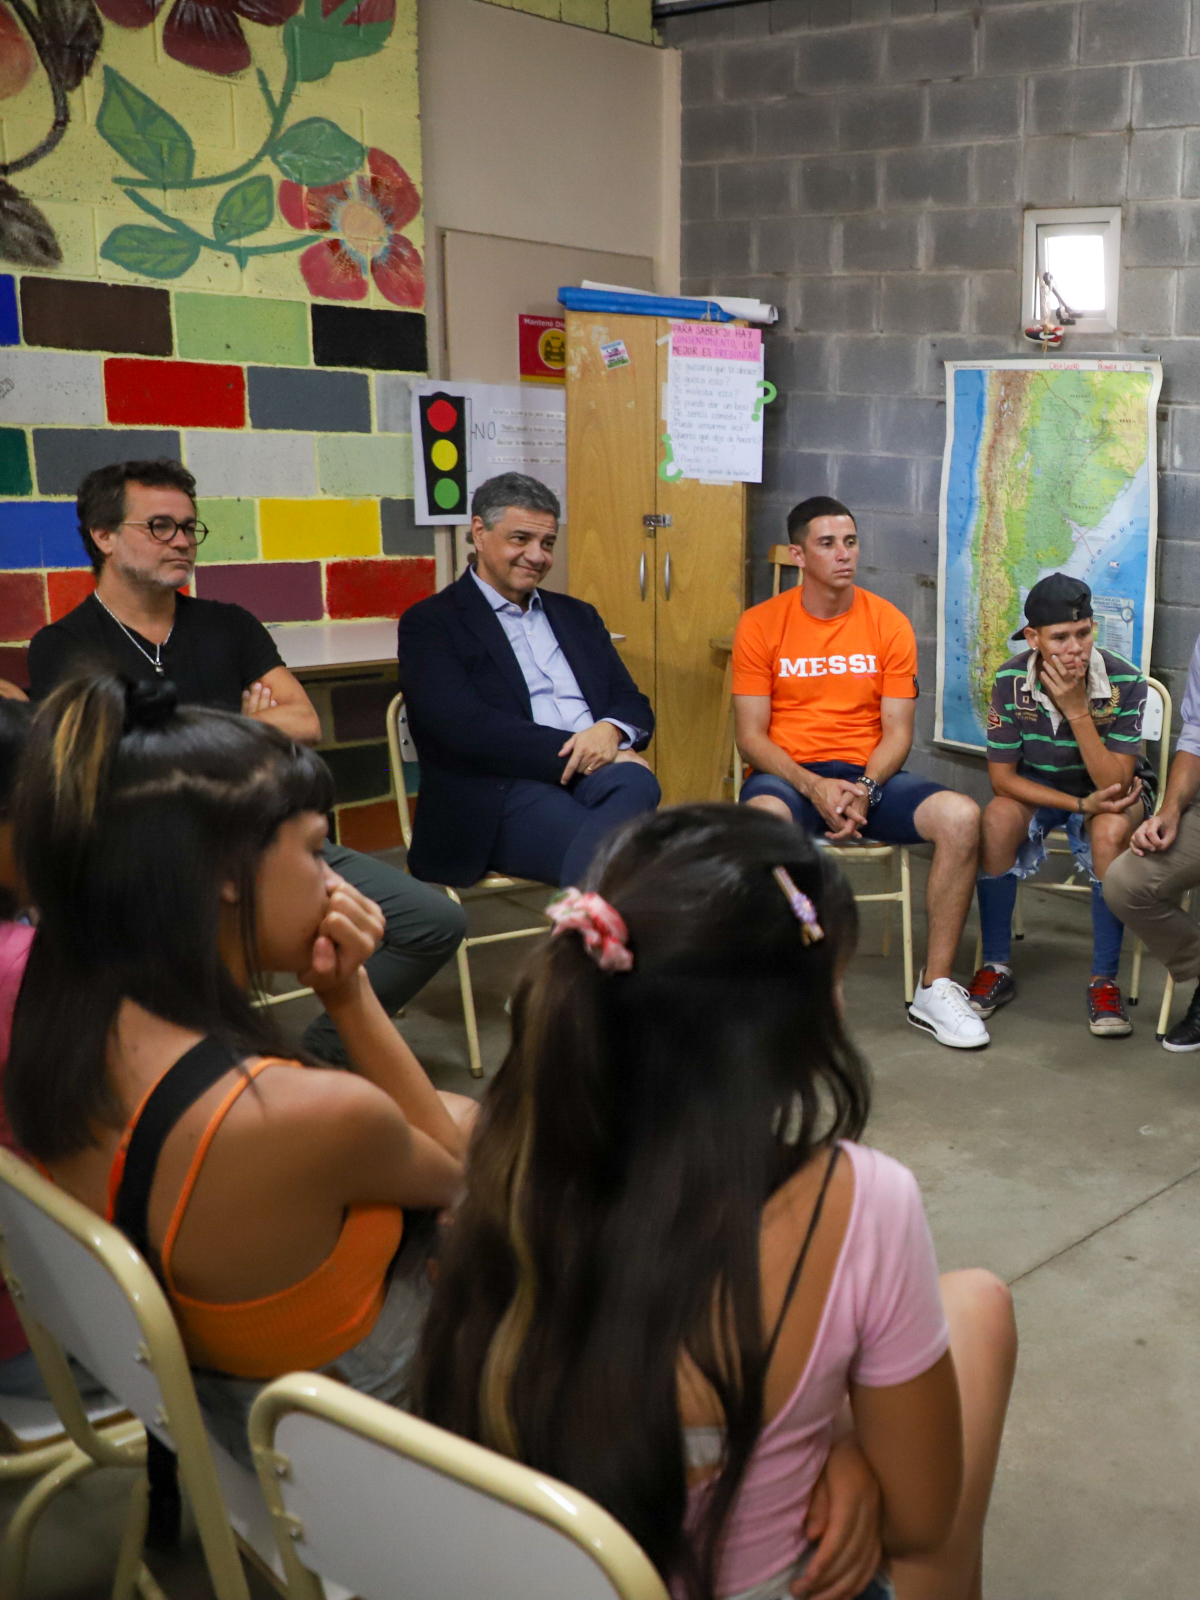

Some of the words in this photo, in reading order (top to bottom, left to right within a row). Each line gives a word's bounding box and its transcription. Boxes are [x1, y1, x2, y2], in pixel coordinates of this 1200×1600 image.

[523, 318, 554, 327] Mantené
[672, 324, 692, 334] PARA
[696, 326, 720, 336] SABER
[735, 329, 753, 339] HAY
[672, 346, 698, 356] MEJOR
[702, 348, 712, 357] ES
[743, 340, 753, 350] LO
[475, 421, 496, 440] NO
[778, 654, 878, 678] MESSI
